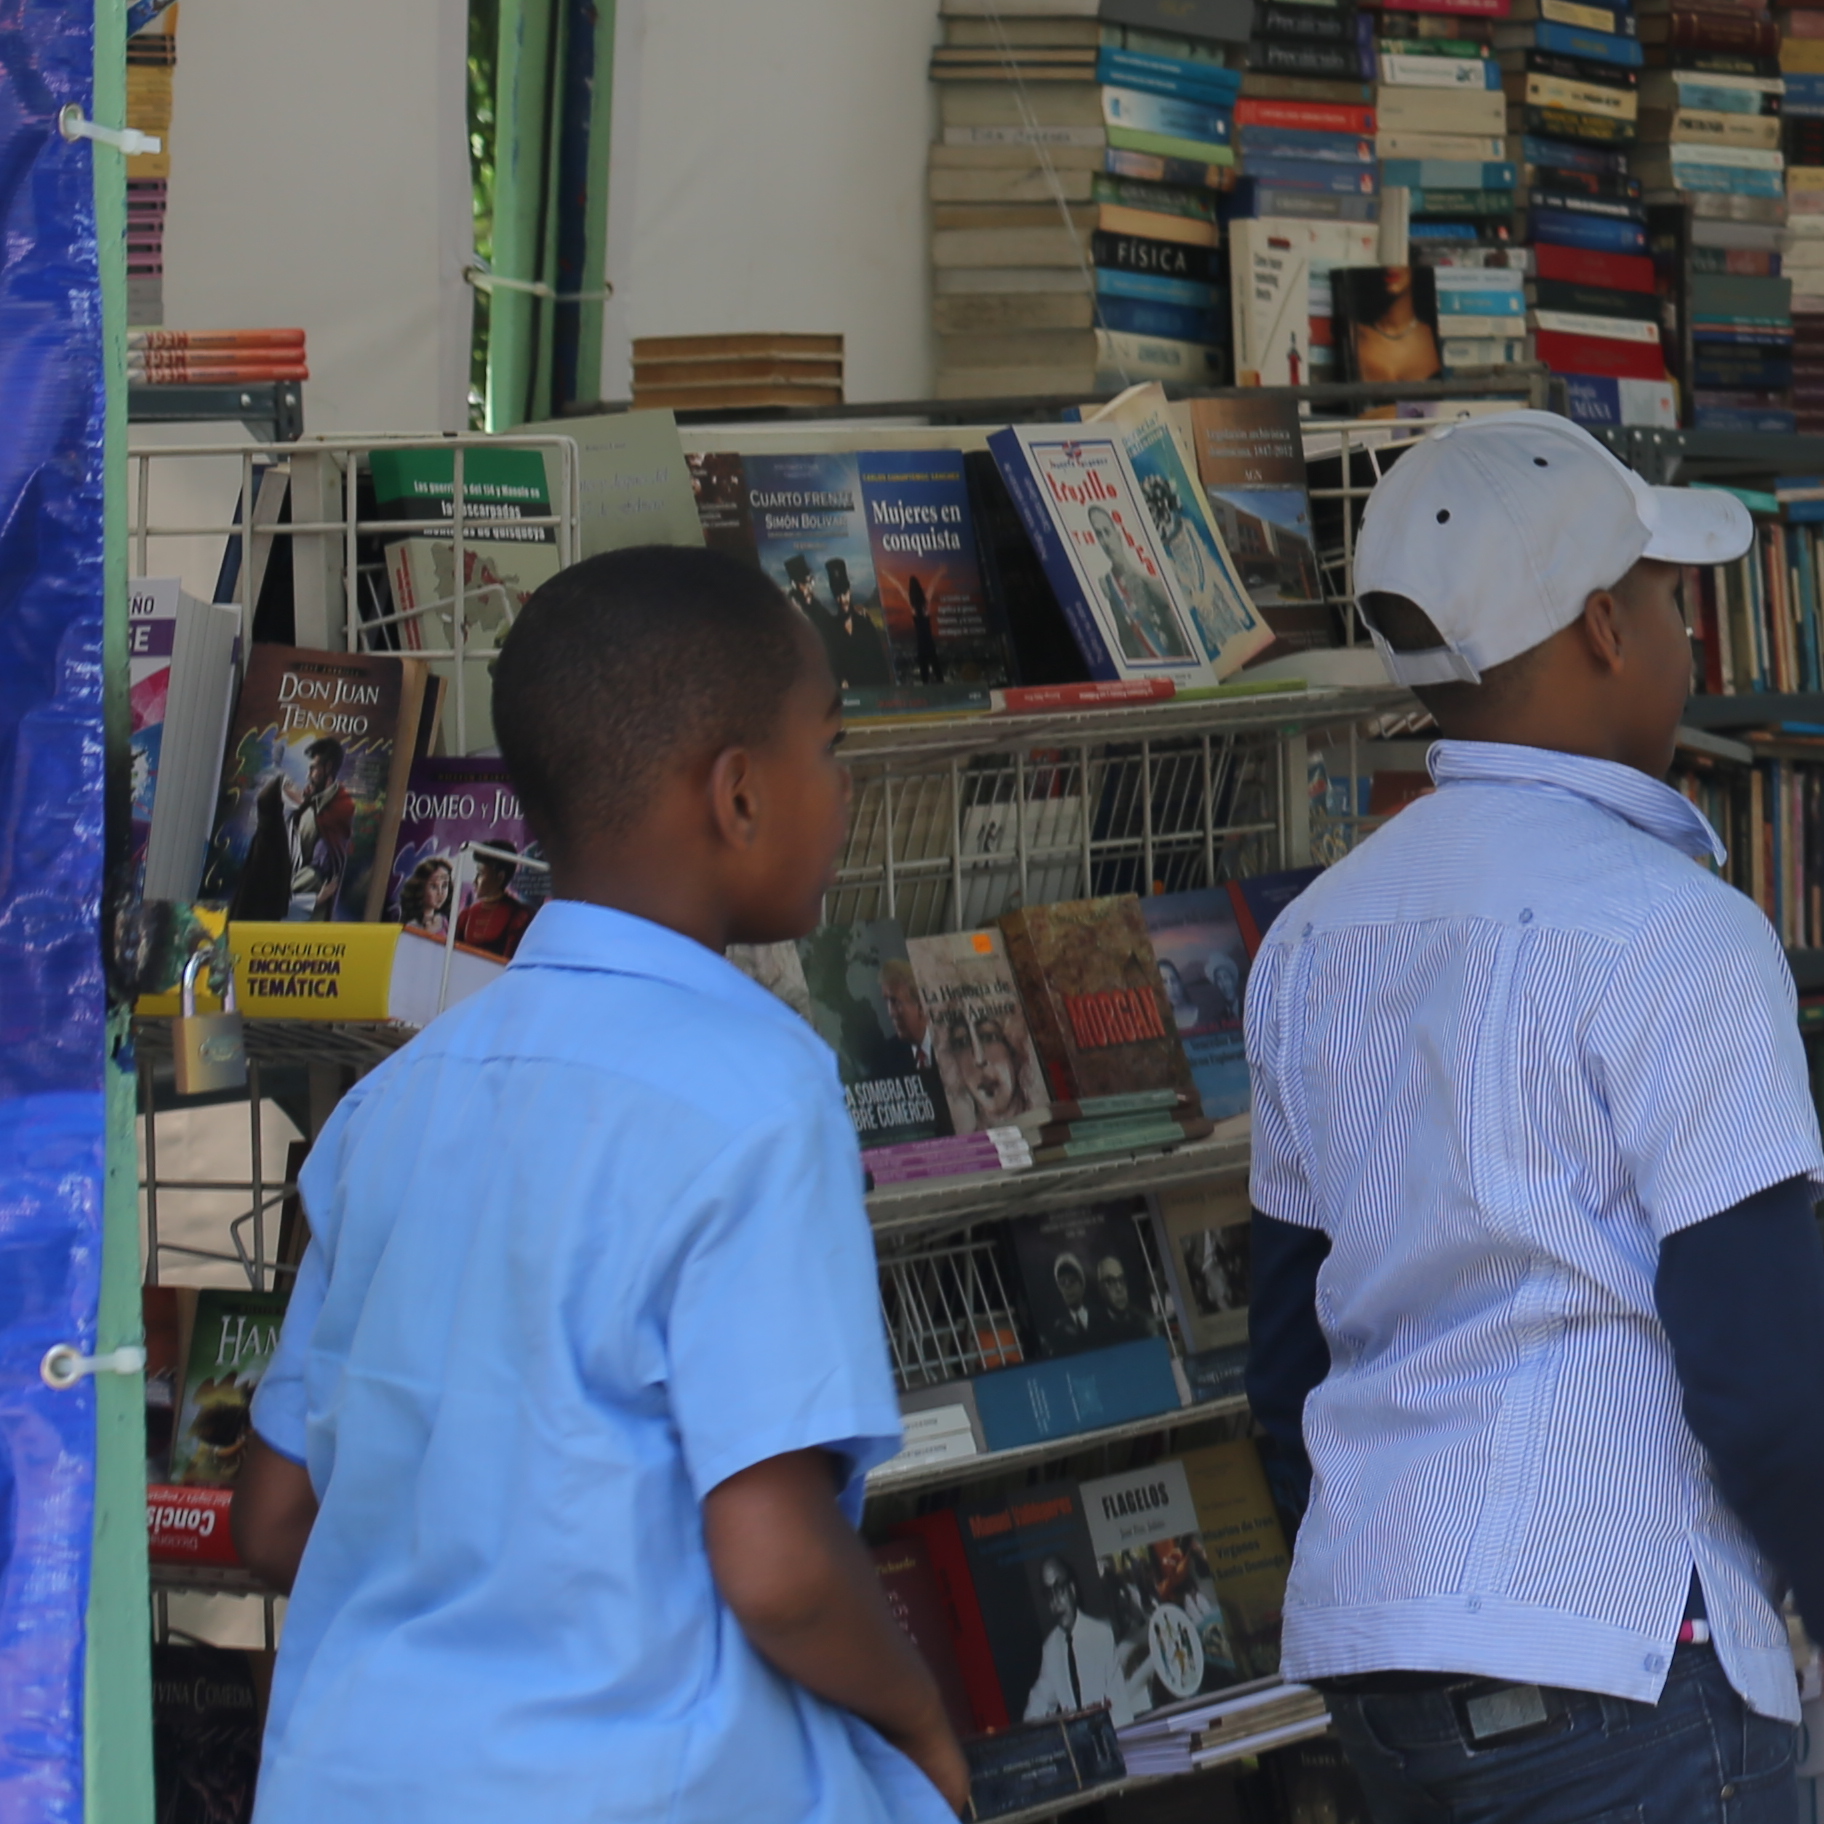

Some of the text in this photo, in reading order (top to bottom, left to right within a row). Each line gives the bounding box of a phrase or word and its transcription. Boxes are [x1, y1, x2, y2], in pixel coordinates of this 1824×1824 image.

[1117, 236, 1187, 272] FÍSICA
[750, 490, 802, 508] CUARTO
[765, 511, 799, 530] SIMÓN
[872, 500, 962, 530] Mujeres en
[882, 527, 962, 557] conquista
[278, 672, 380, 709] DON JUAN
[279, 704, 369, 735] TENORIO
[402, 790, 475, 824] ROMEO
[250, 942, 346, 958] CONSULTOR
[248, 960, 341, 975] ENCICLOPEDIA
[247, 973, 338, 998] TEMÁTICA
[1063, 985, 1166, 1049] MORGAN
[855, 1078, 905, 1106] SOMBRA
[904, 1074, 928, 1099] DEL
[877, 1098, 935, 1128] COMERCIO
[1101, 1481, 1169, 1521] FLAGELOS
[194, 1676, 253, 1714] COMEDIA
